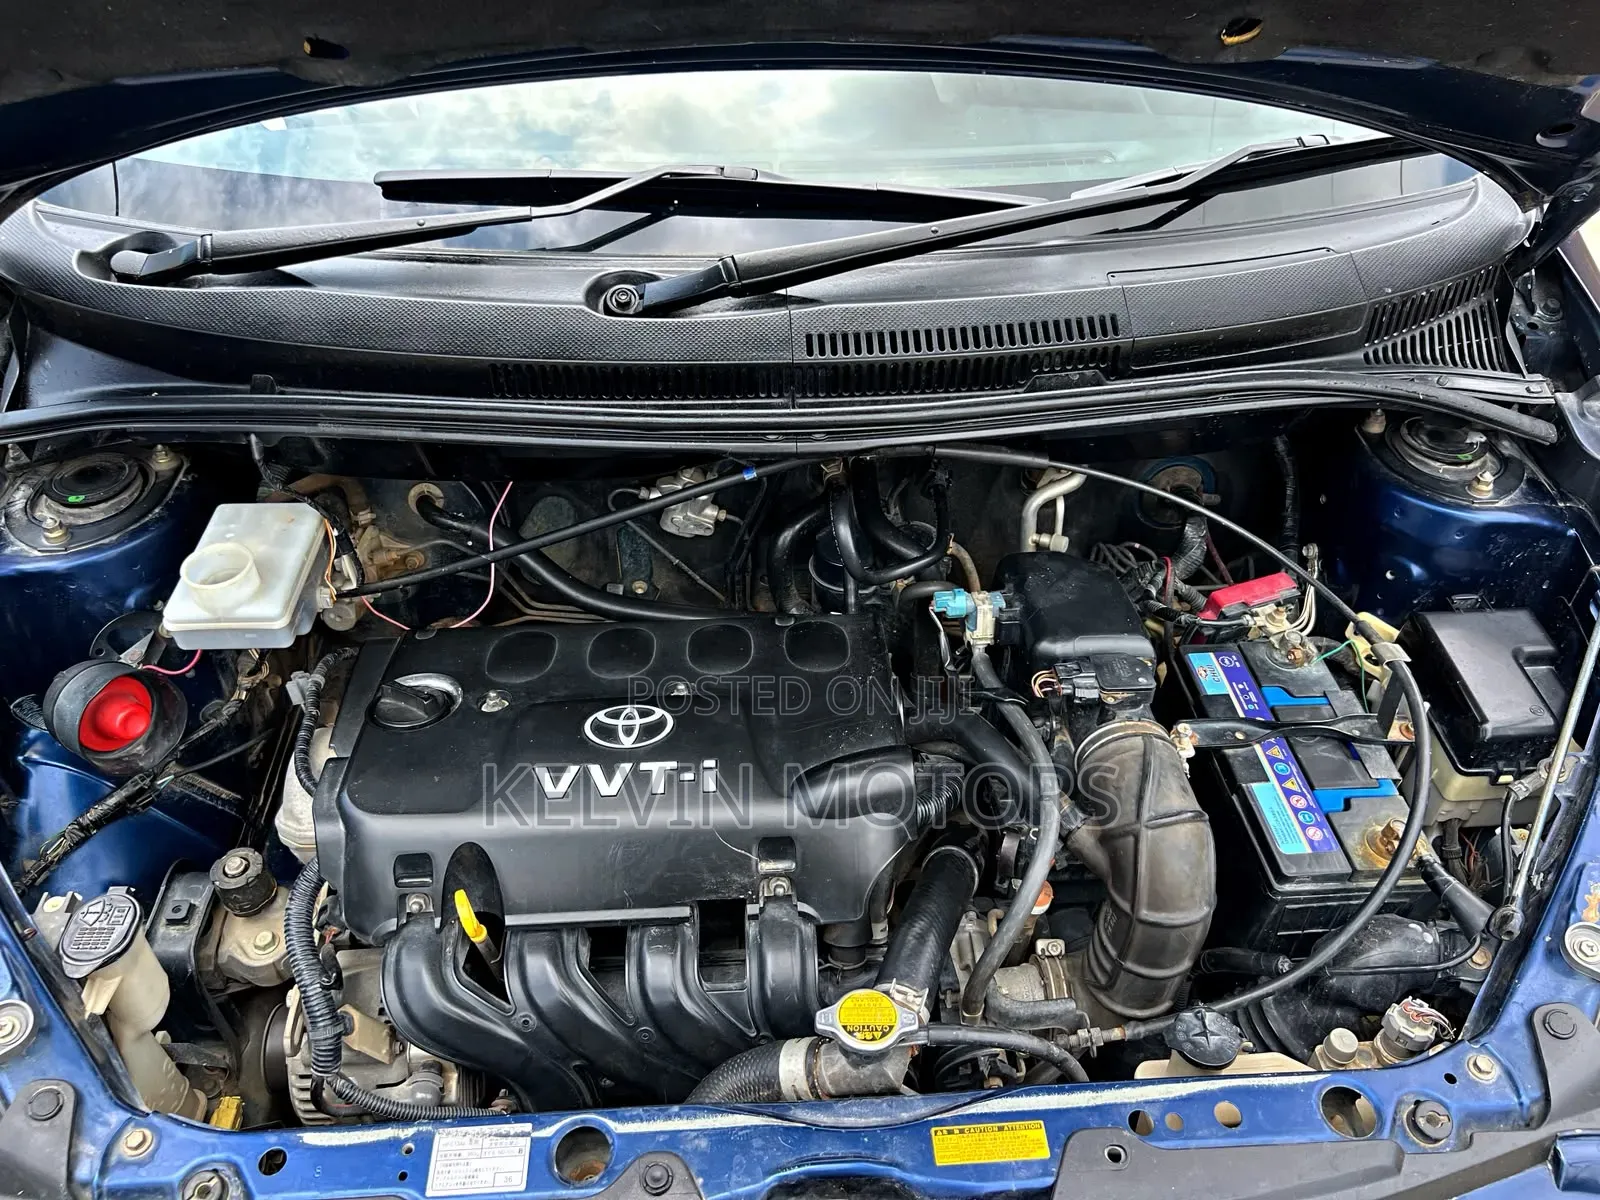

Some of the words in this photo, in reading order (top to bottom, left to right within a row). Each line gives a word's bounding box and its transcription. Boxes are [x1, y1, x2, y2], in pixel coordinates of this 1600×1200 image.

[533, 759, 719, 799] VVT-i
[964, 1126, 999, 1134] CAUTION
[1003, 1123, 1041, 1131] ATTENTION
